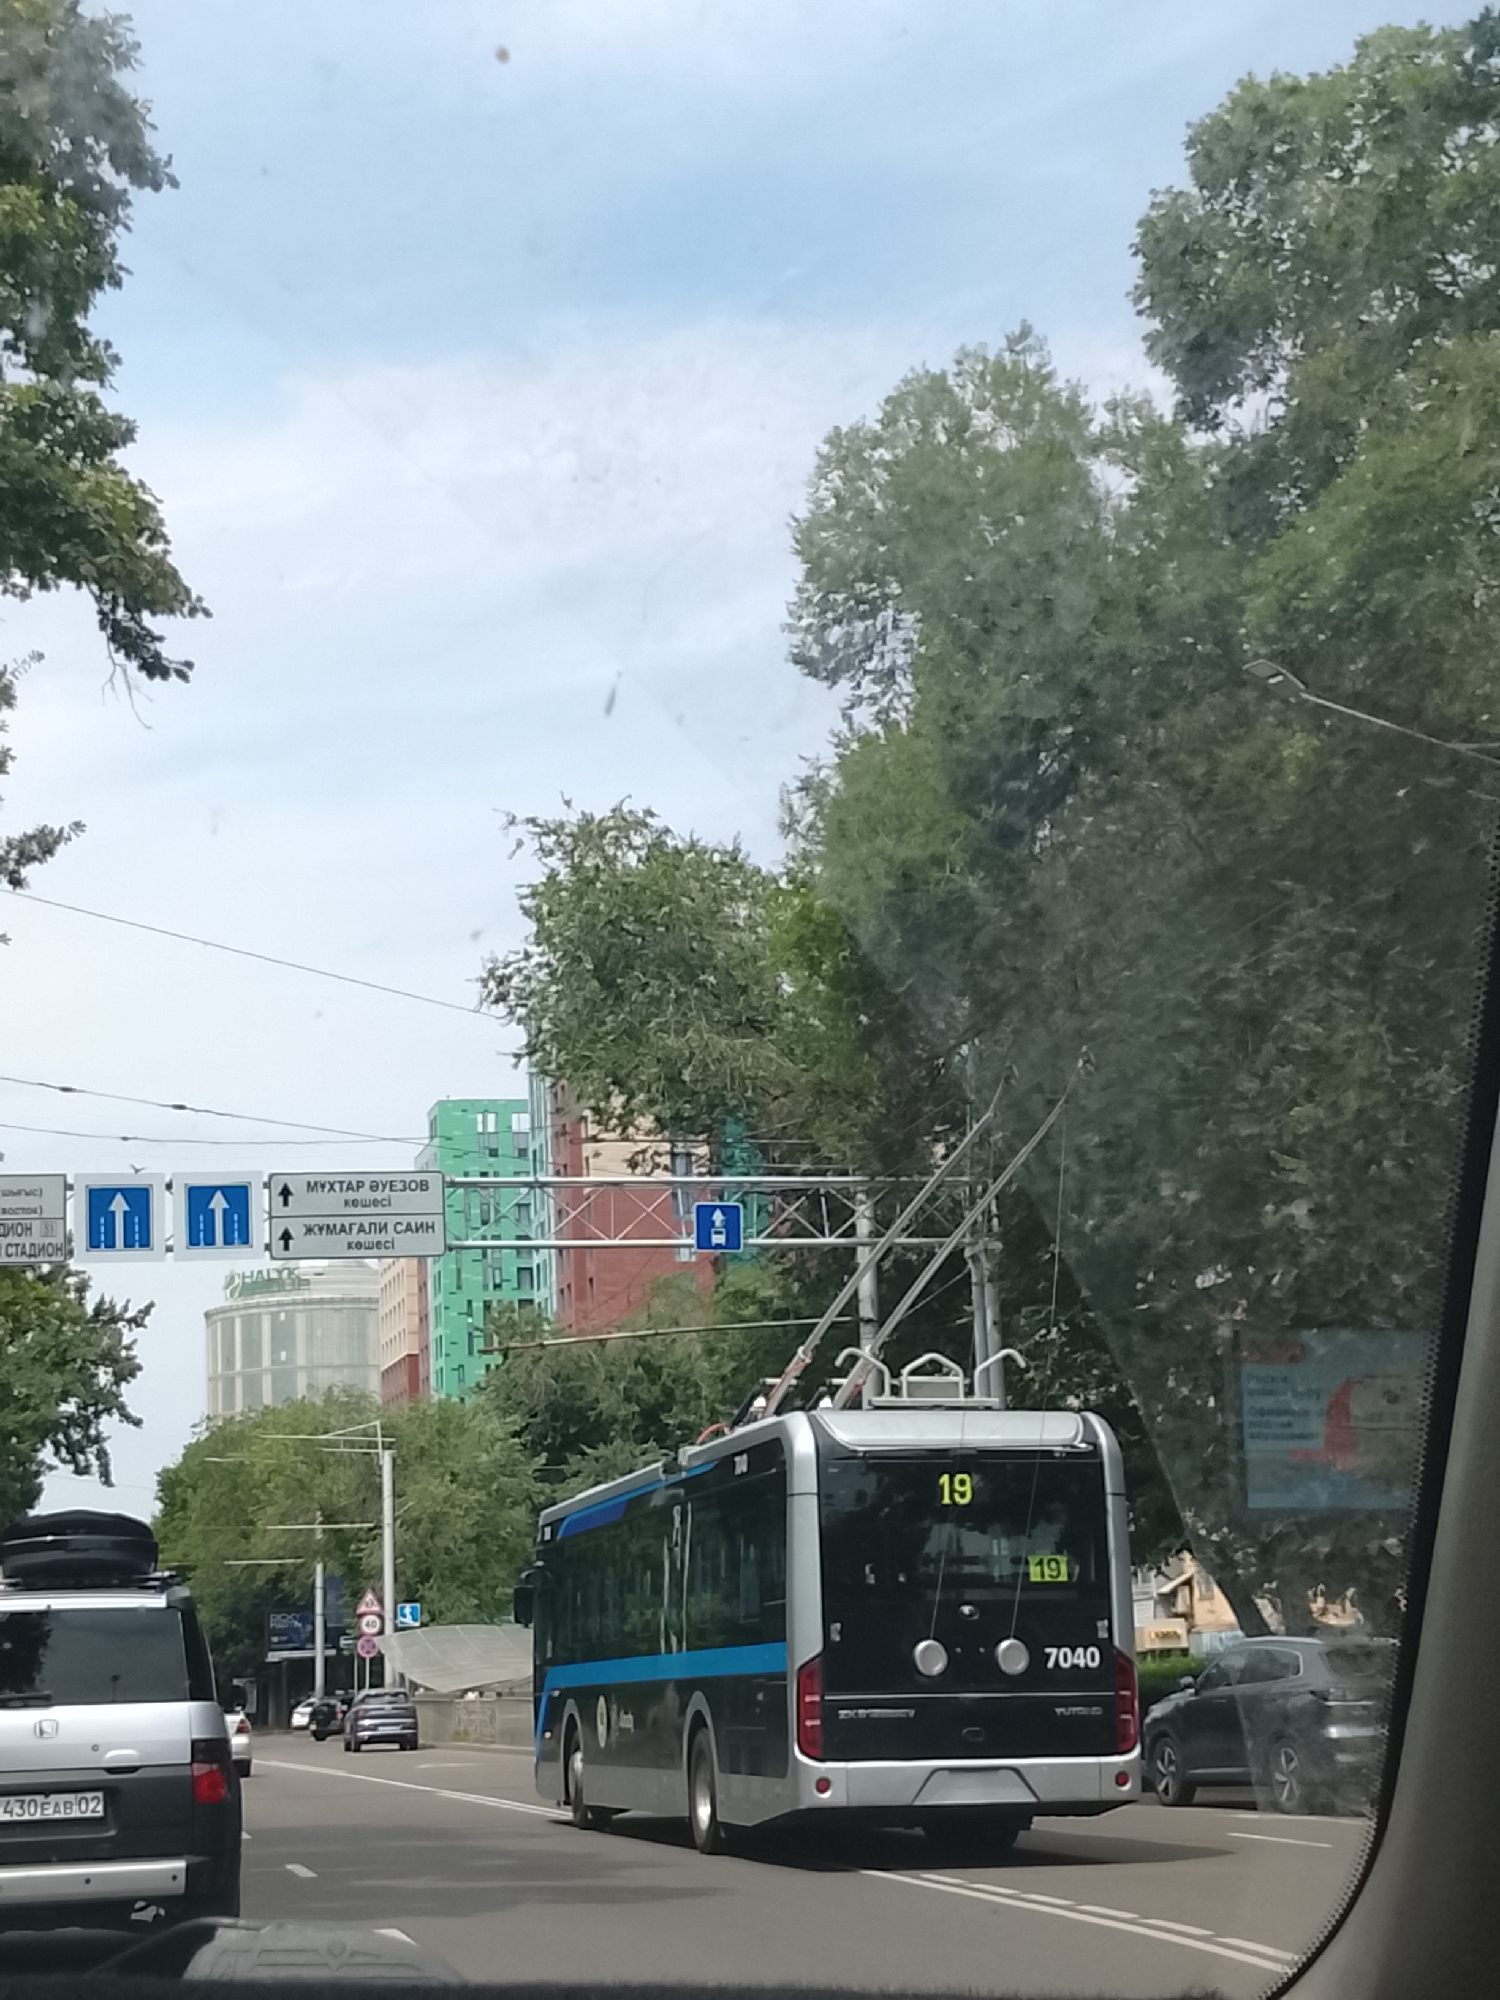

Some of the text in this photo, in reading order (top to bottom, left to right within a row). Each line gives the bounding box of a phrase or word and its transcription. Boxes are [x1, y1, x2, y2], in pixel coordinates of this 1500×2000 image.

[369, 1179, 430, 1192] ӘУЕЗОВ
[393, 1220, 435, 1234] САИН
[5, 1242, 64, 1259] СТАДИОН
[939, 1473, 973, 1505] 19
[1034, 1558, 1062, 1580] 19
[364, 1620, 378, 1629] 40
[1044, 1646, 1101, 1670] 7040
